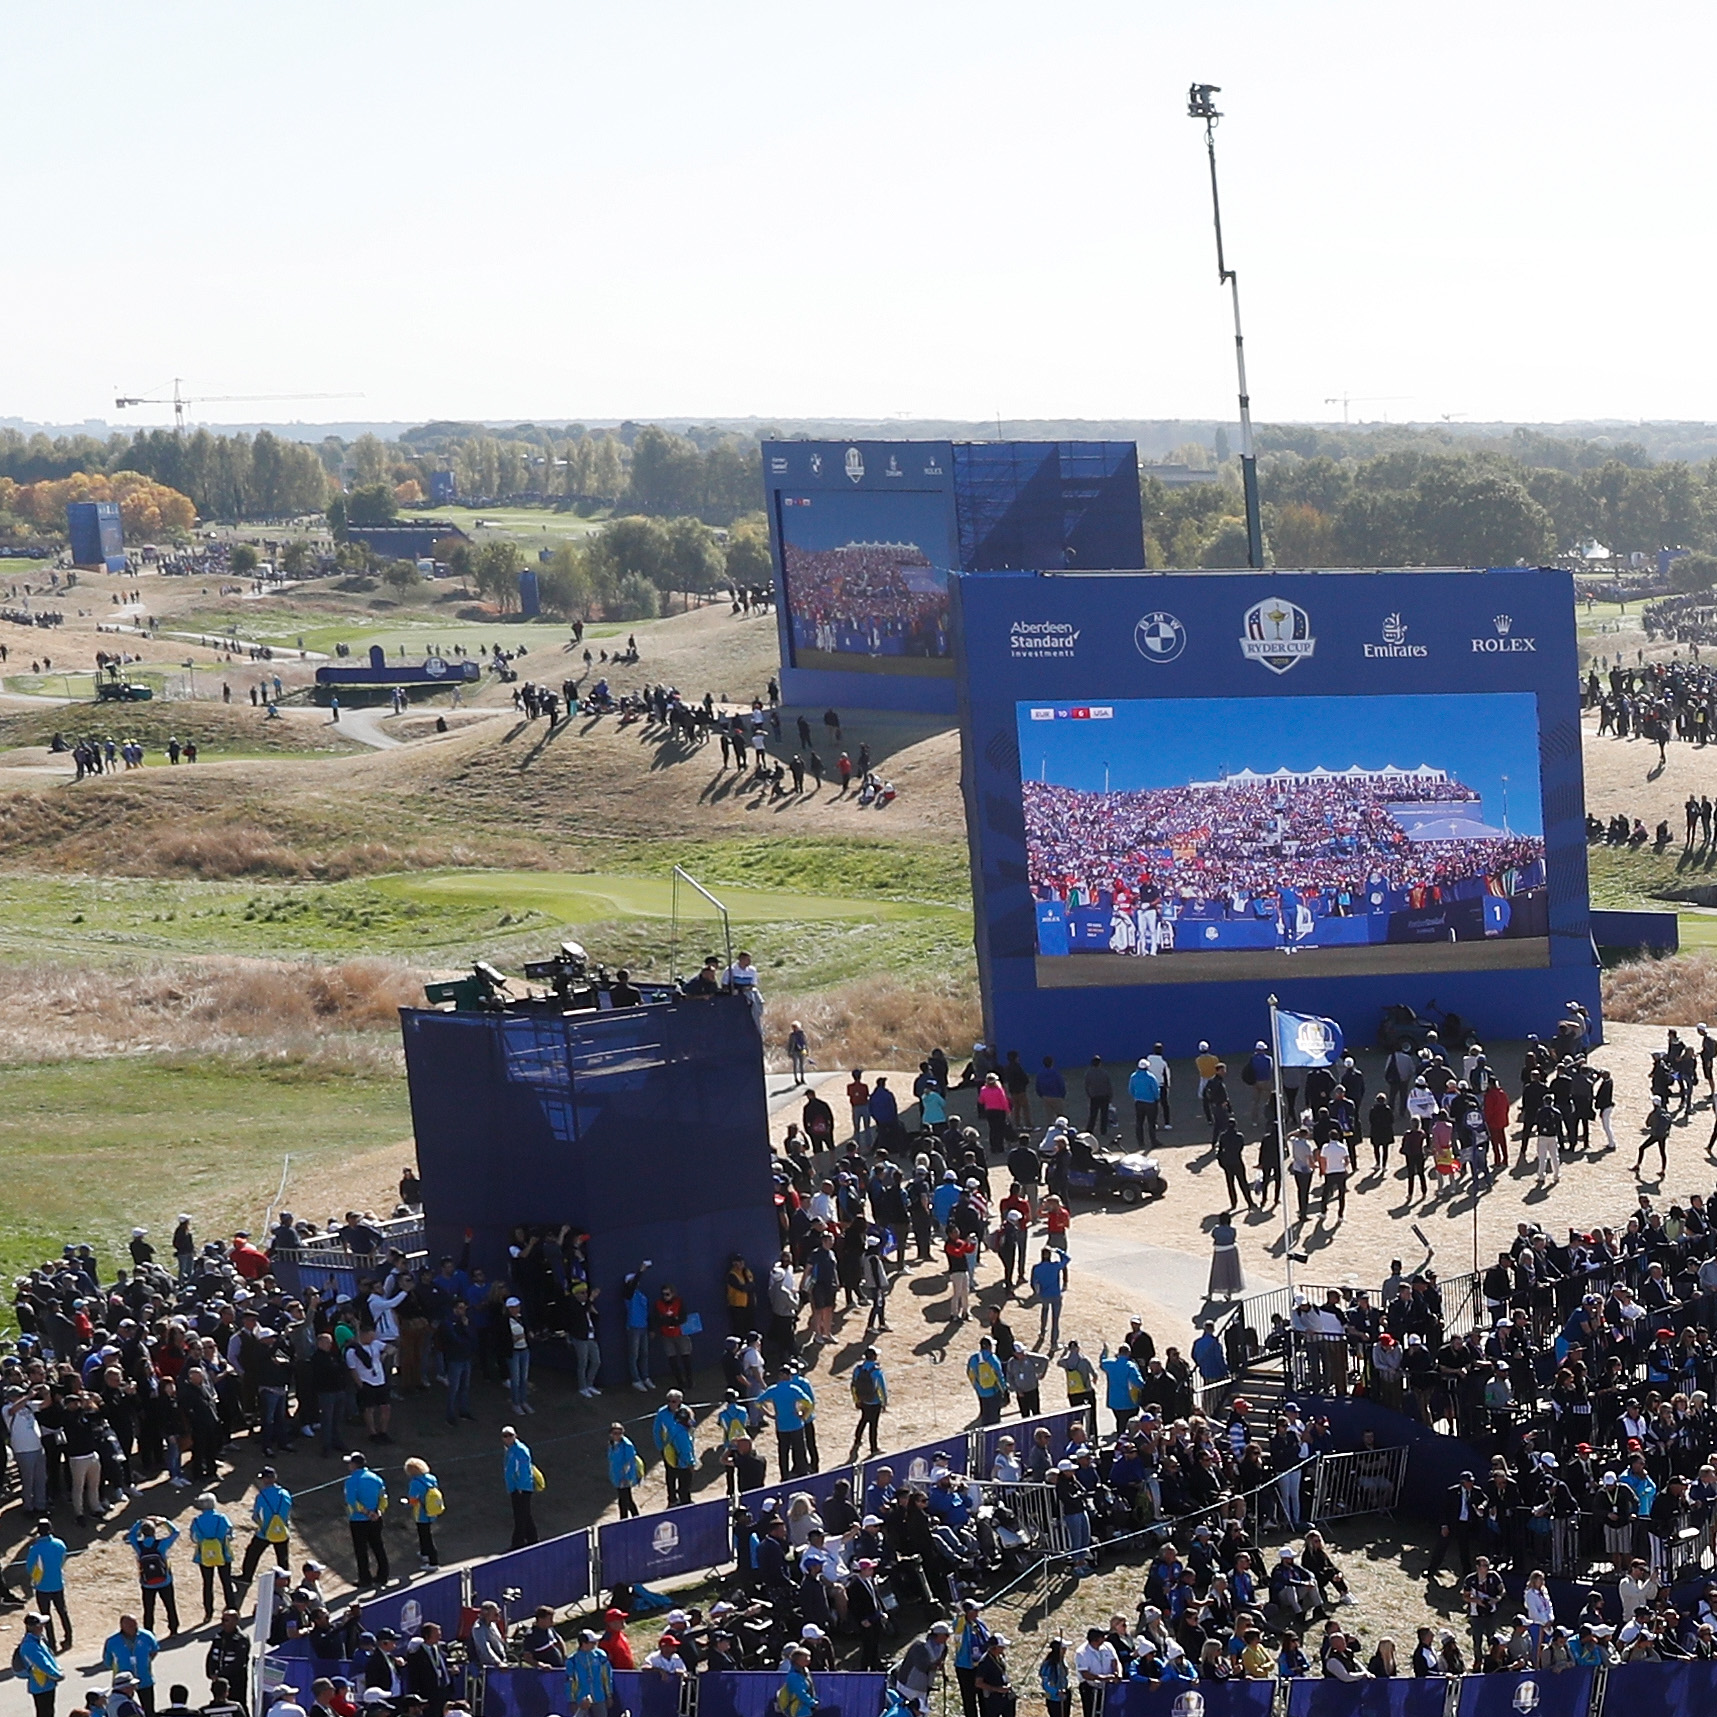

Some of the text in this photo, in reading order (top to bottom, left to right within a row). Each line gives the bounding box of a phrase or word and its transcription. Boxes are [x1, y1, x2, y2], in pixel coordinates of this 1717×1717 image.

[1010, 621, 1072, 634] Aberdeen
[1139, 613, 1183, 631] BMW
[1010, 634, 1074, 648] Standard
[1246, 641, 1311, 653] RYDER CUP
[1471, 638, 1537, 652] ROLEX
[1363, 644, 1428, 658] Emirates
